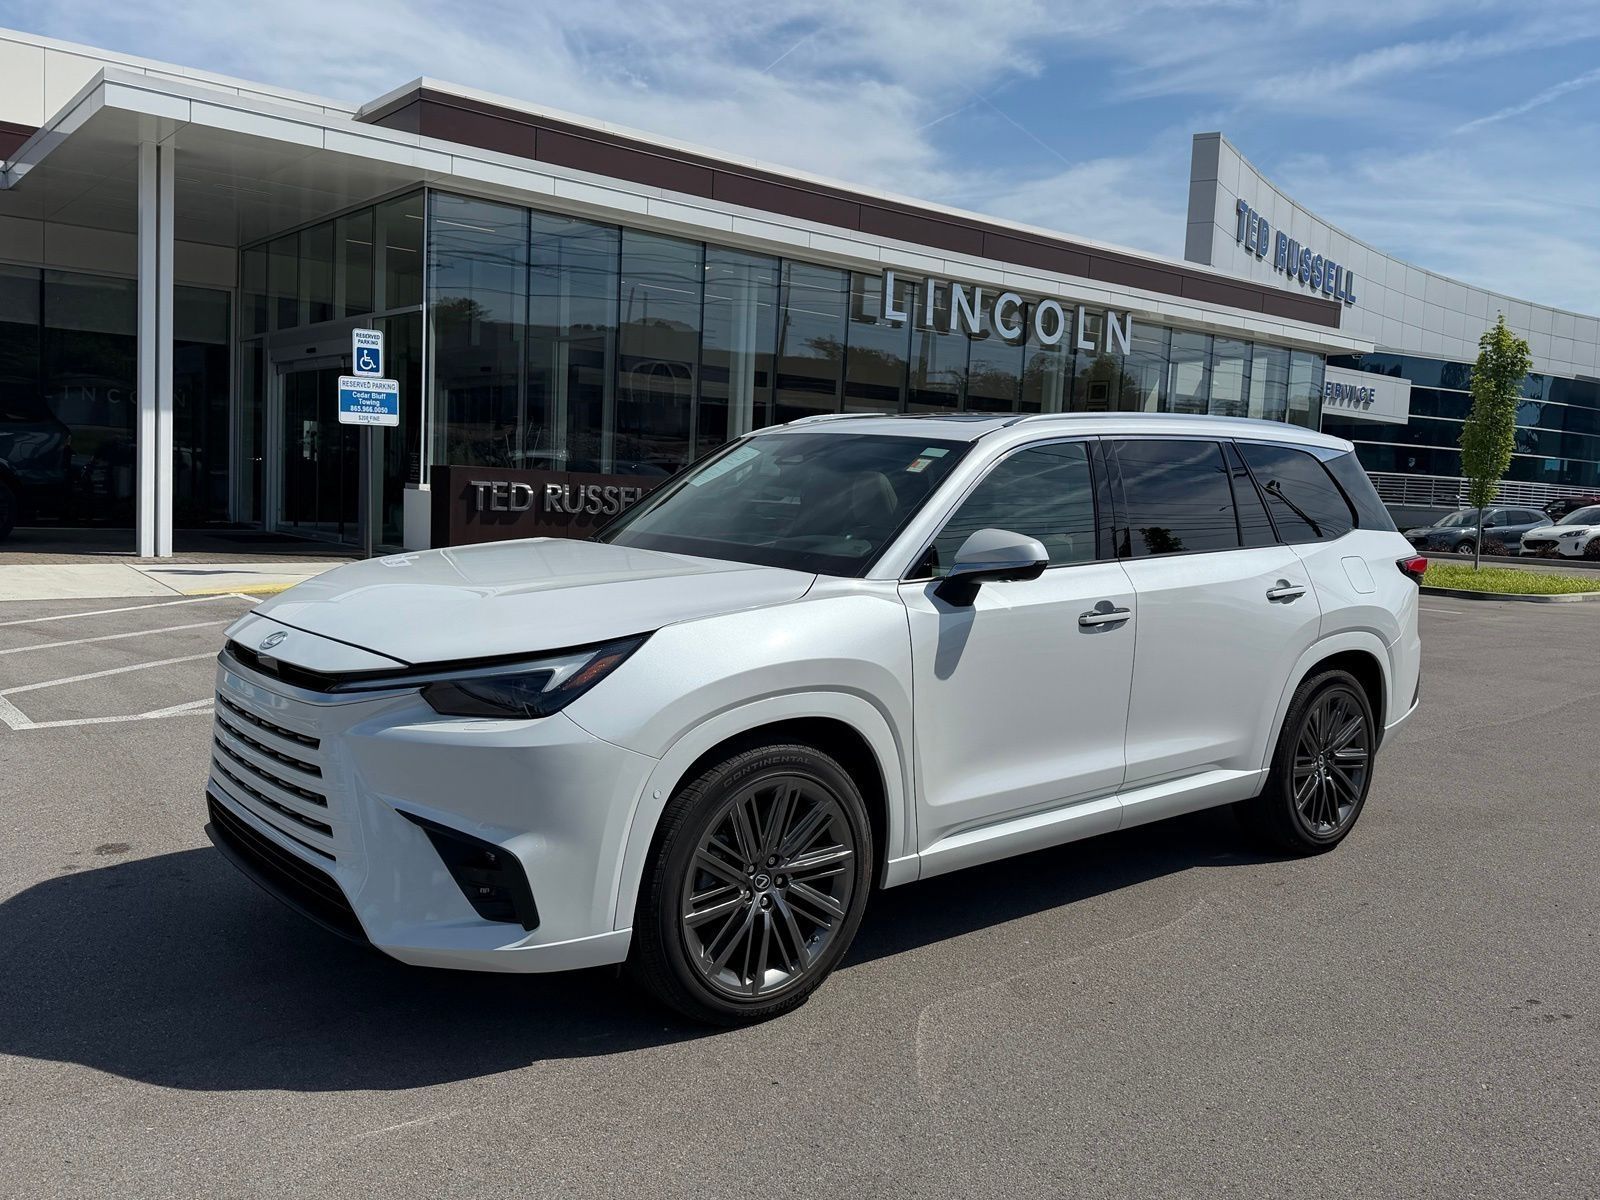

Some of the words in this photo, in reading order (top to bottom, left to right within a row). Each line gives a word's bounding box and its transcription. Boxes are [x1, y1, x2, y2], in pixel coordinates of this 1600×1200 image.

[1236, 198, 1269, 257] TED
[1274, 230, 1356, 304] RUSSELL
[882, 267, 1132, 355] LINCOLN
[355, 332, 380, 340] RESERVED
[341, 380, 371, 389] RESERVED
[372, 382, 396, 391] PARKING
[352, 391, 370, 399] Cedar
[371, 392, 387, 400] Bluff
[1325, 381, 1376, 403] ERVICE
[471, 480, 534, 512] TED
[723, 755, 812, 787] CONTINENTAL
